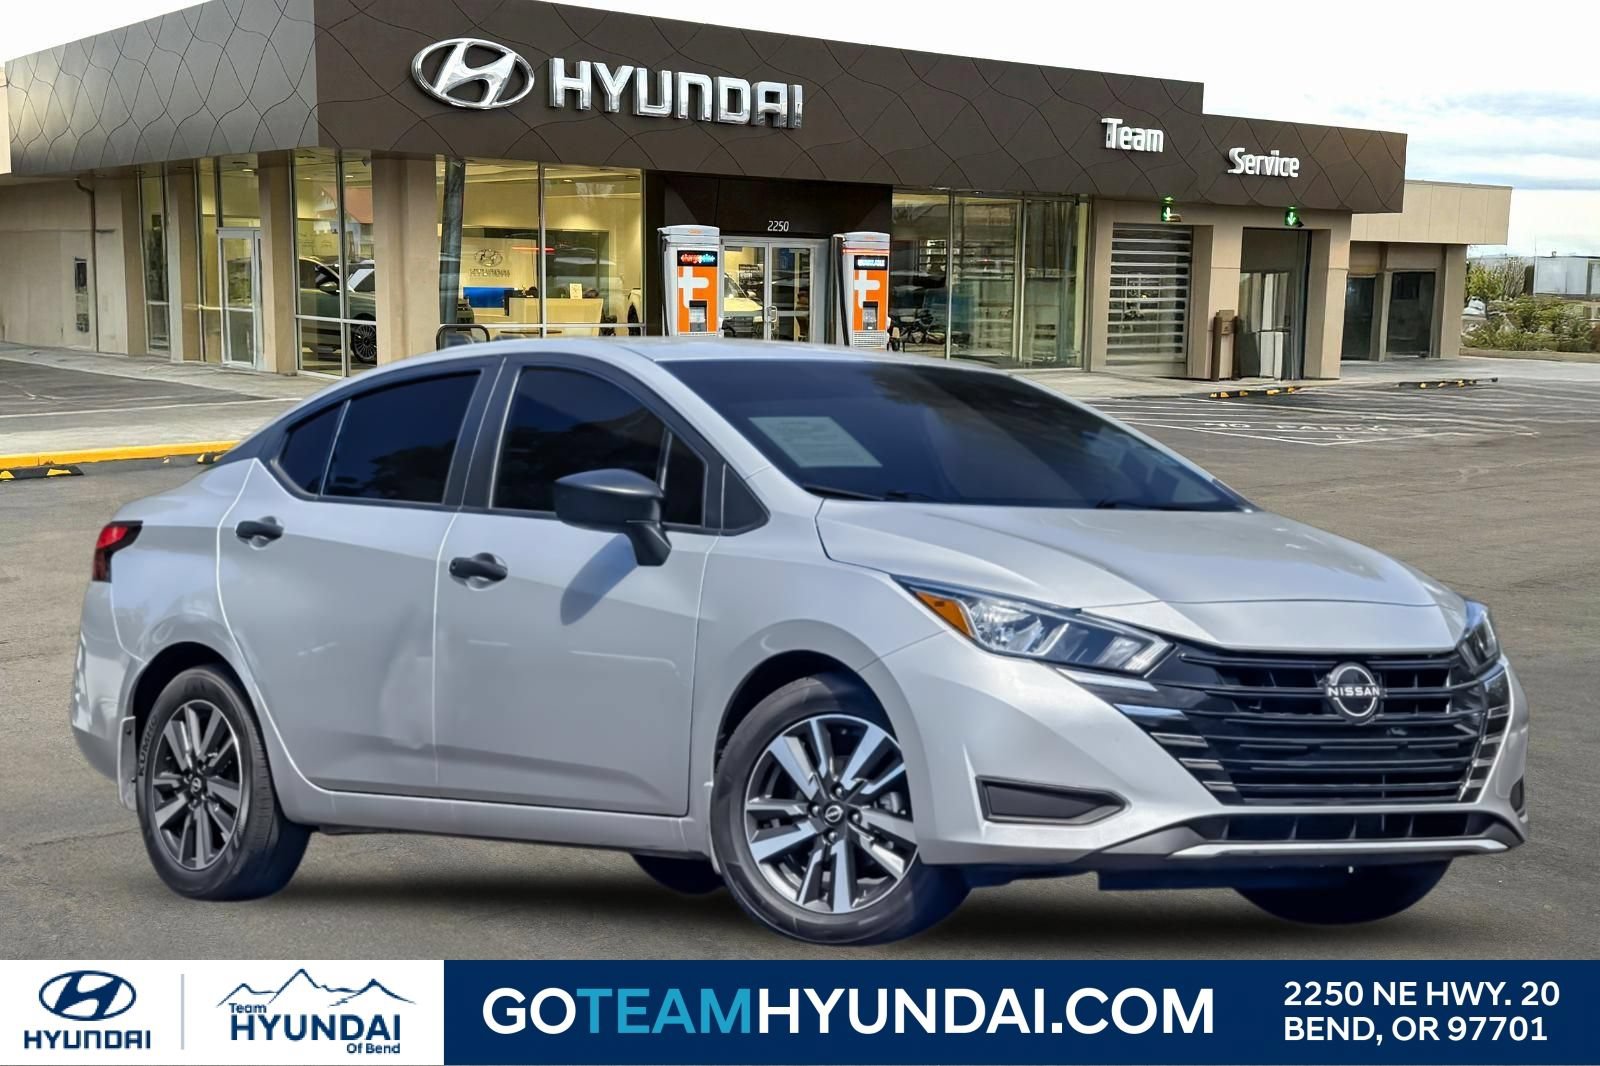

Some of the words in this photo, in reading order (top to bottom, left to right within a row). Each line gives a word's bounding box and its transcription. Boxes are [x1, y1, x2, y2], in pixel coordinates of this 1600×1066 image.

[549, 58, 804, 128] HYUNDAI
[1101, 117, 1164, 153] Team
[1227, 147, 1301, 178] Service
[767, 220, 790, 232] 2250
[1327, 686, 1380, 697] NISSAN
